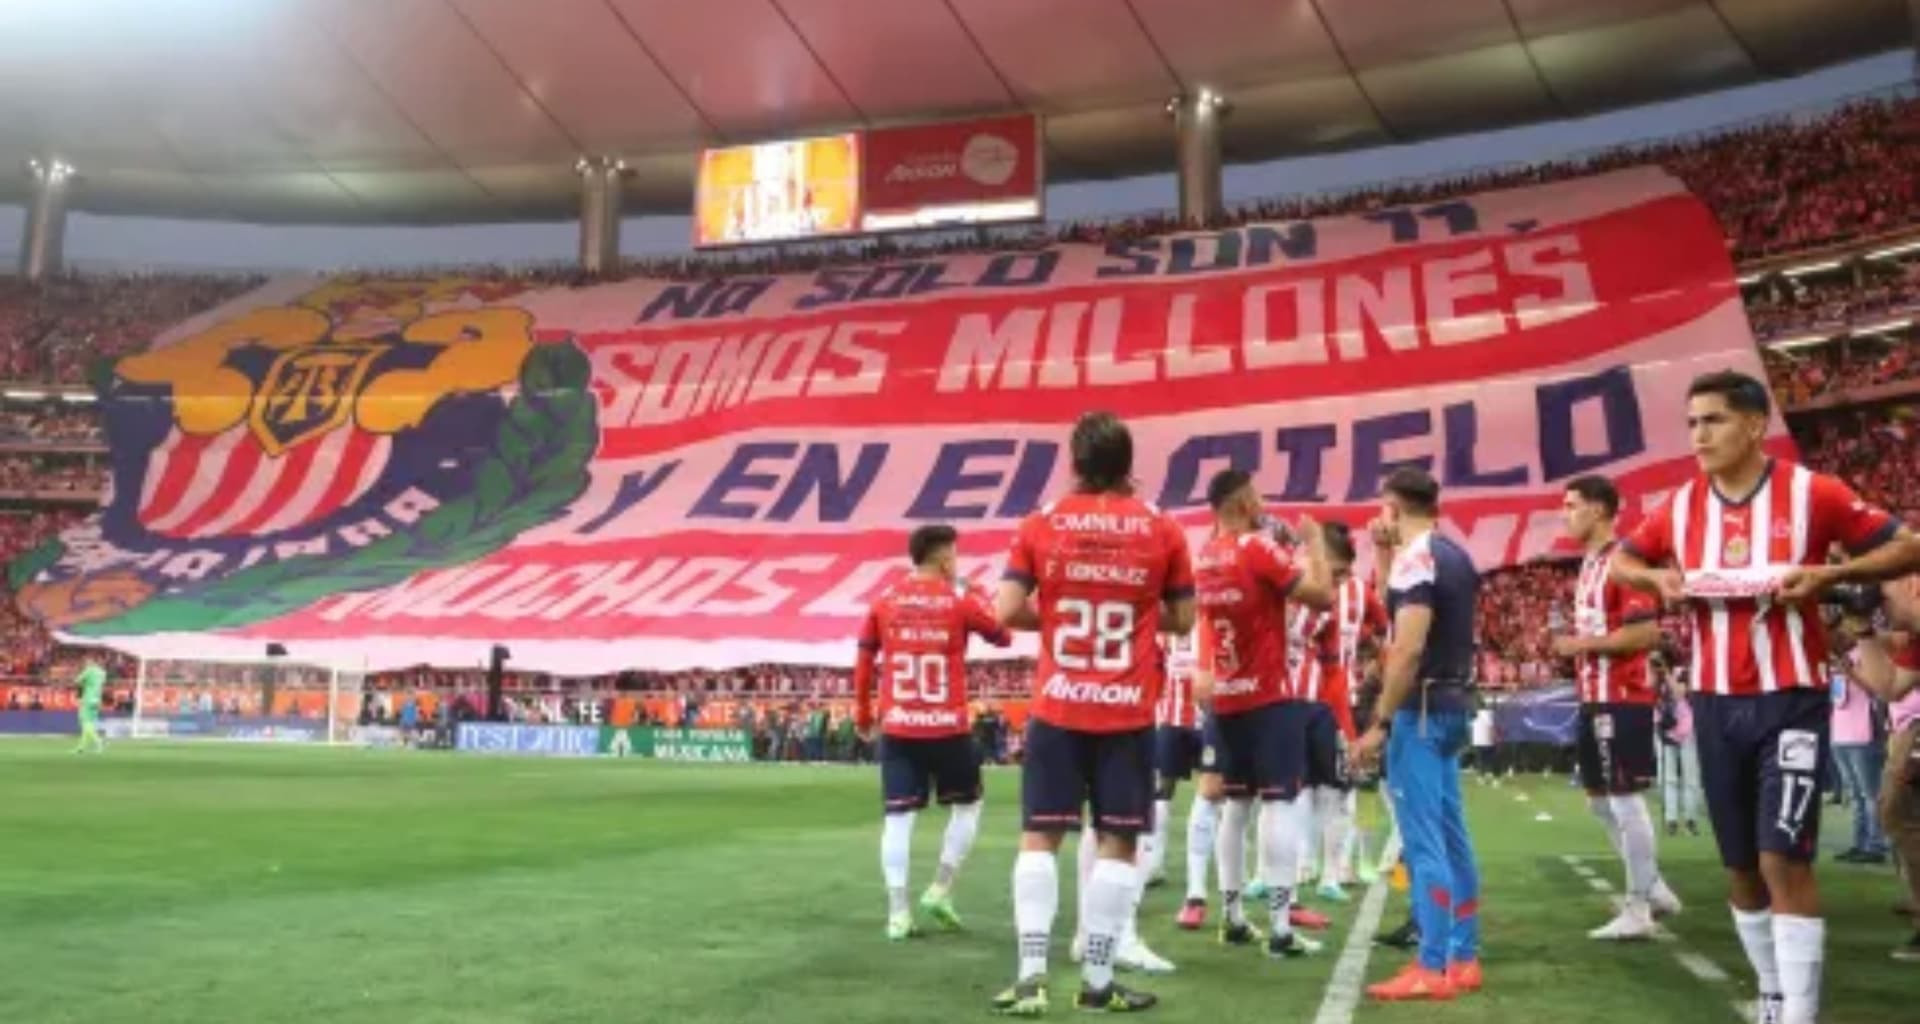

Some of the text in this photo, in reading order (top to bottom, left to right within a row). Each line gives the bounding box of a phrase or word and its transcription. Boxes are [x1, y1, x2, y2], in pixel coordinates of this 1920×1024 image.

[793, 249, 1060, 308] SOLO
[1096, 219, 1318, 276] SON
[593, 233, 1600, 430] SOMOS MILLONES
[685, 440, 891, 523] EN
[1053, 598, 1135, 671] 28
[892, 653, 946, 704] 20
[1780, 774, 1815, 824] 17
